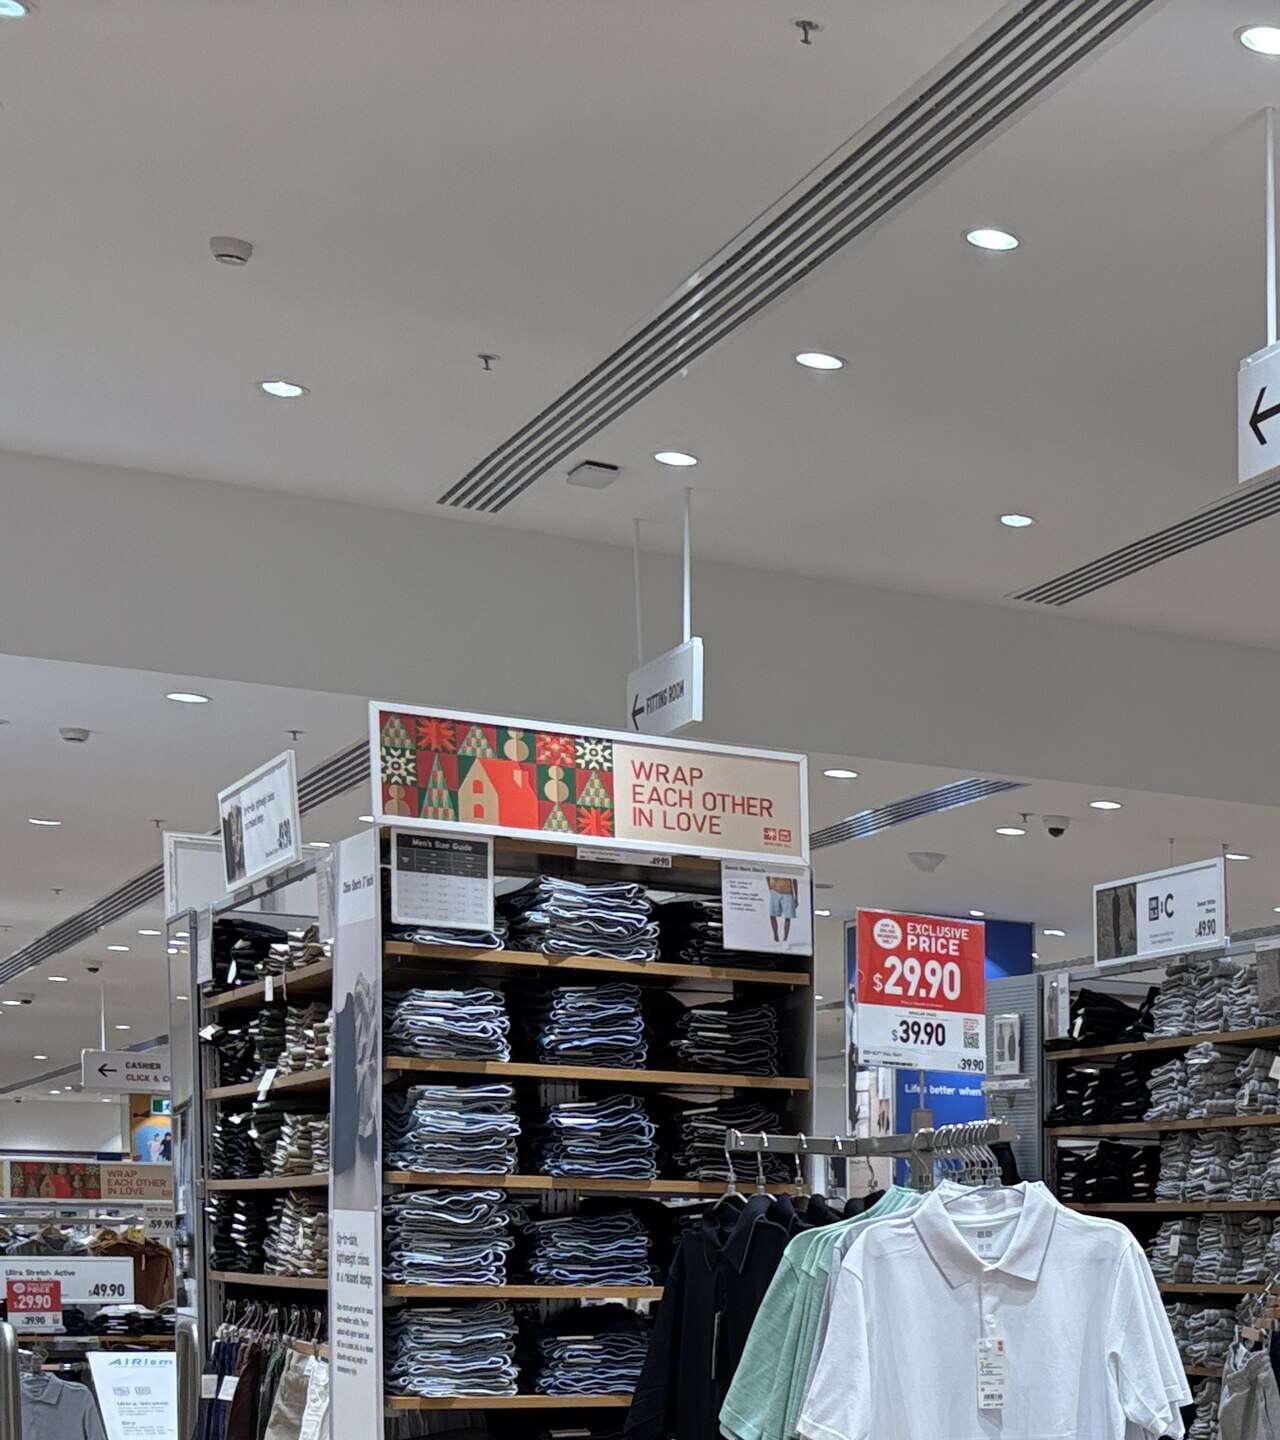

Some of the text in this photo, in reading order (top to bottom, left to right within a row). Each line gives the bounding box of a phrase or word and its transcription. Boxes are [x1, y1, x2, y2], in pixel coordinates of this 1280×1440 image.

[630, 760, 703, 787] WRAP
[632, 784, 774, 818] EACH OTHER
[632, 807, 722, 835] IN LOVE
[906, 922, 969, 941] EXCLUSIVE
[906, 934, 960, 956] PRICE
[872, 955, 961, 1001] $29.90
[891, 1019, 946, 1047] $39.90
[125, 1061, 162, 1071] CASHIER
[929, 1084, 983, 1097] better when
[107, 1169, 138, 1178] WRAP
[107, 1178, 167, 1188] EACH OTHER
[119, 1187, 145, 1196] LOVE
[108, 1357, 173, 1366] AIRism
